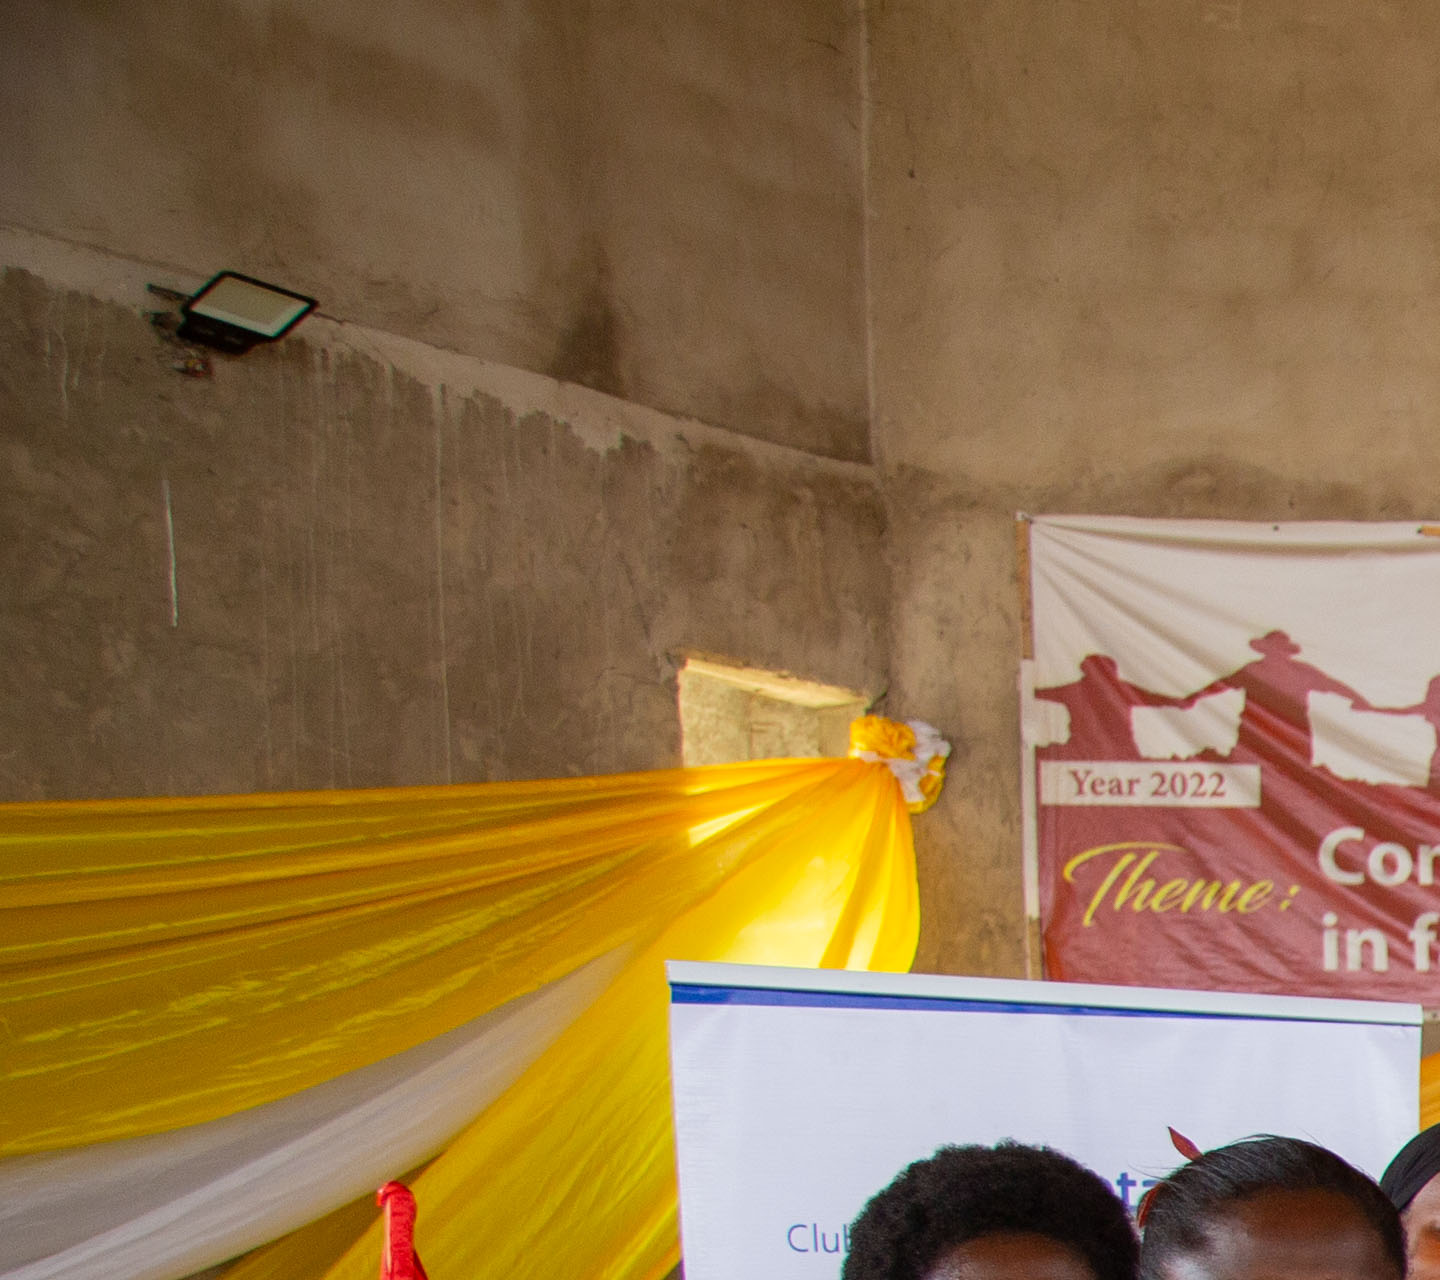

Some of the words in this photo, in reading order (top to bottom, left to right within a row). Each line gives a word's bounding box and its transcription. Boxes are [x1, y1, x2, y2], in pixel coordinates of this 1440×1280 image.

[1069, 770, 1140, 798] Year
[1151, 771, 1227, 798] 2022
[1063, 841, 1301, 928] Theme:
[1321, 912, 1389, 972] in
